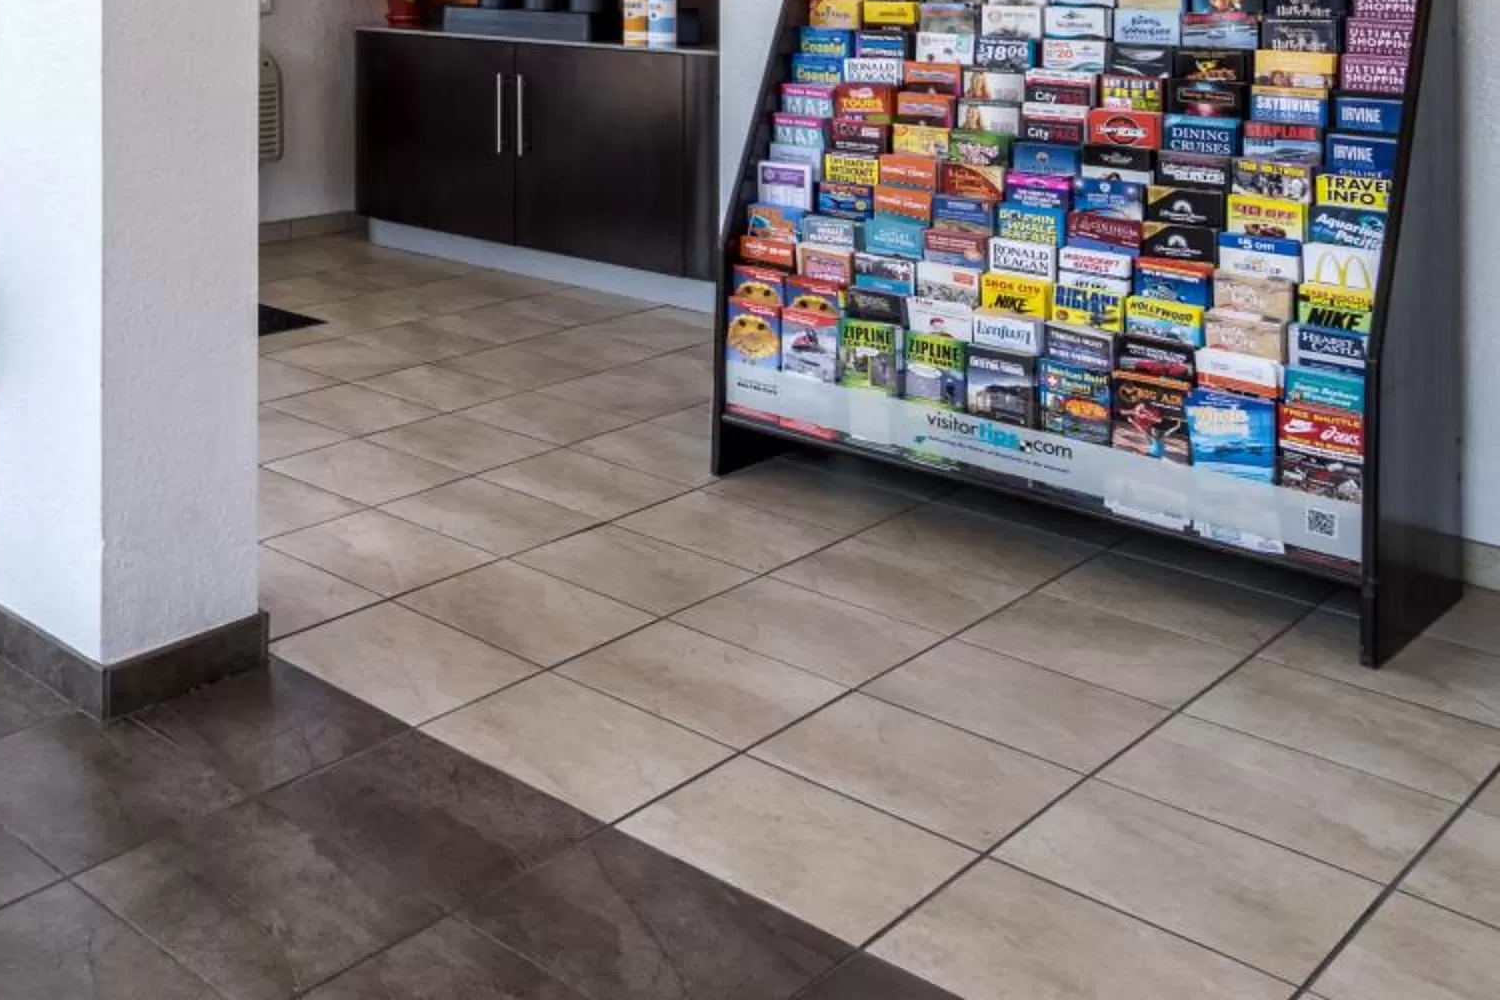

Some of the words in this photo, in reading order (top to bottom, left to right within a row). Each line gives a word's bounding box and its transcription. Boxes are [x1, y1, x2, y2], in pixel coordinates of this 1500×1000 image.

[1357, 2, 1415, 12] SHOPPIN
[1348, 27, 1411, 40] ULTIMAT
[1345, 63, 1408, 79] ULTIMAT
[1345, 73, 1405, 86] SHOPPIN
[1341, 106, 1381, 123] IRVINE
[1171, 127, 1229, 142] DINING
[1170, 139, 1231, 155] CRUISES
[1333, 144, 1374, 162] IRVINE
[1328, 189, 1375, 205] INFO
[993, 243, 1049, 260] RONALD
[993, 255, 1049, 272] REAGAN
[994, 294, 1029, 312] NIKE
[1307, 307, 1364, 331] NIKE
[843, 325, 894, 345] ZIPLINE
[909, 338, 960, 361] ZIPLINE
